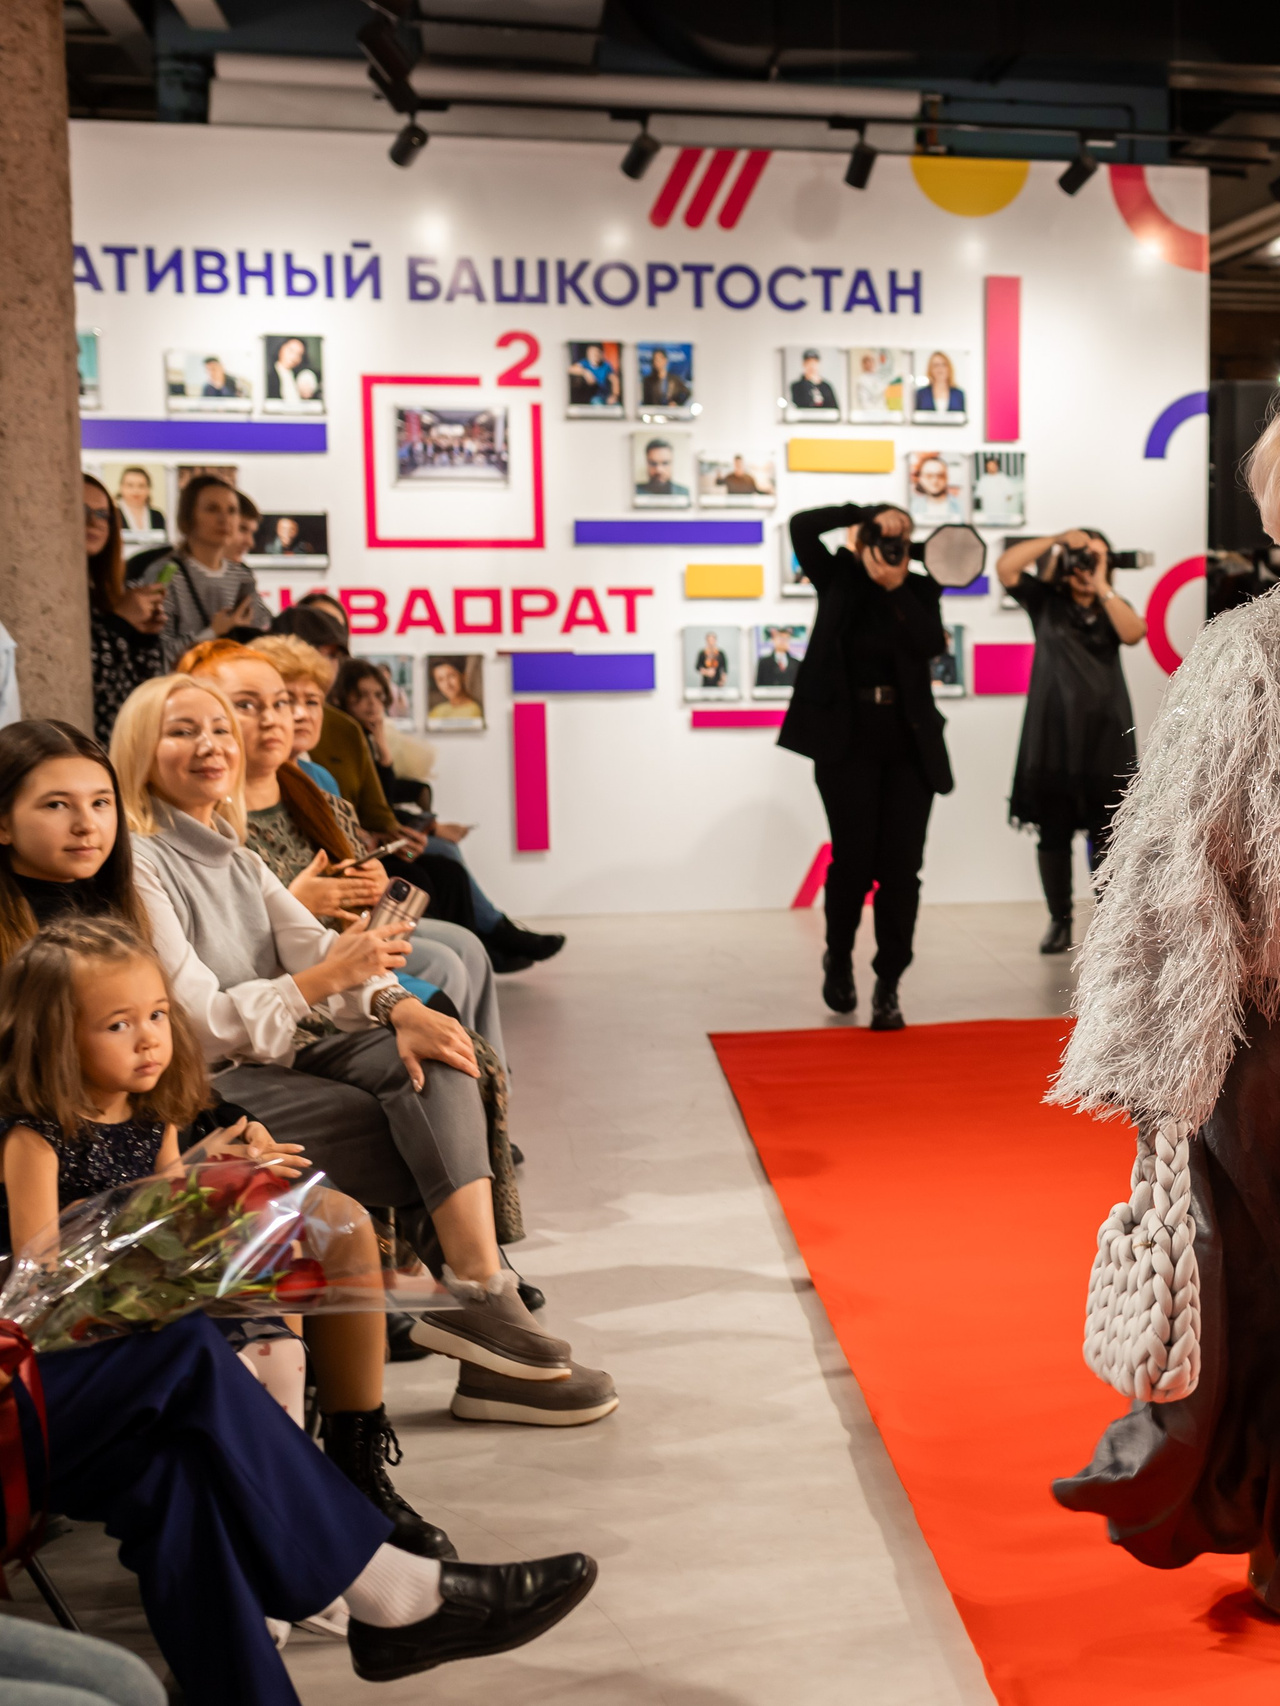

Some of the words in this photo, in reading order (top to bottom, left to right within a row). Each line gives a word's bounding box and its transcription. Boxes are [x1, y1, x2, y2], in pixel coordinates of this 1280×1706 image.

[73, 240, 382, 300] АТИВНЫЙ
[406, 255, 922, 315] БАШКОРТОСТАН
[495, 330, 541, 387] 2
